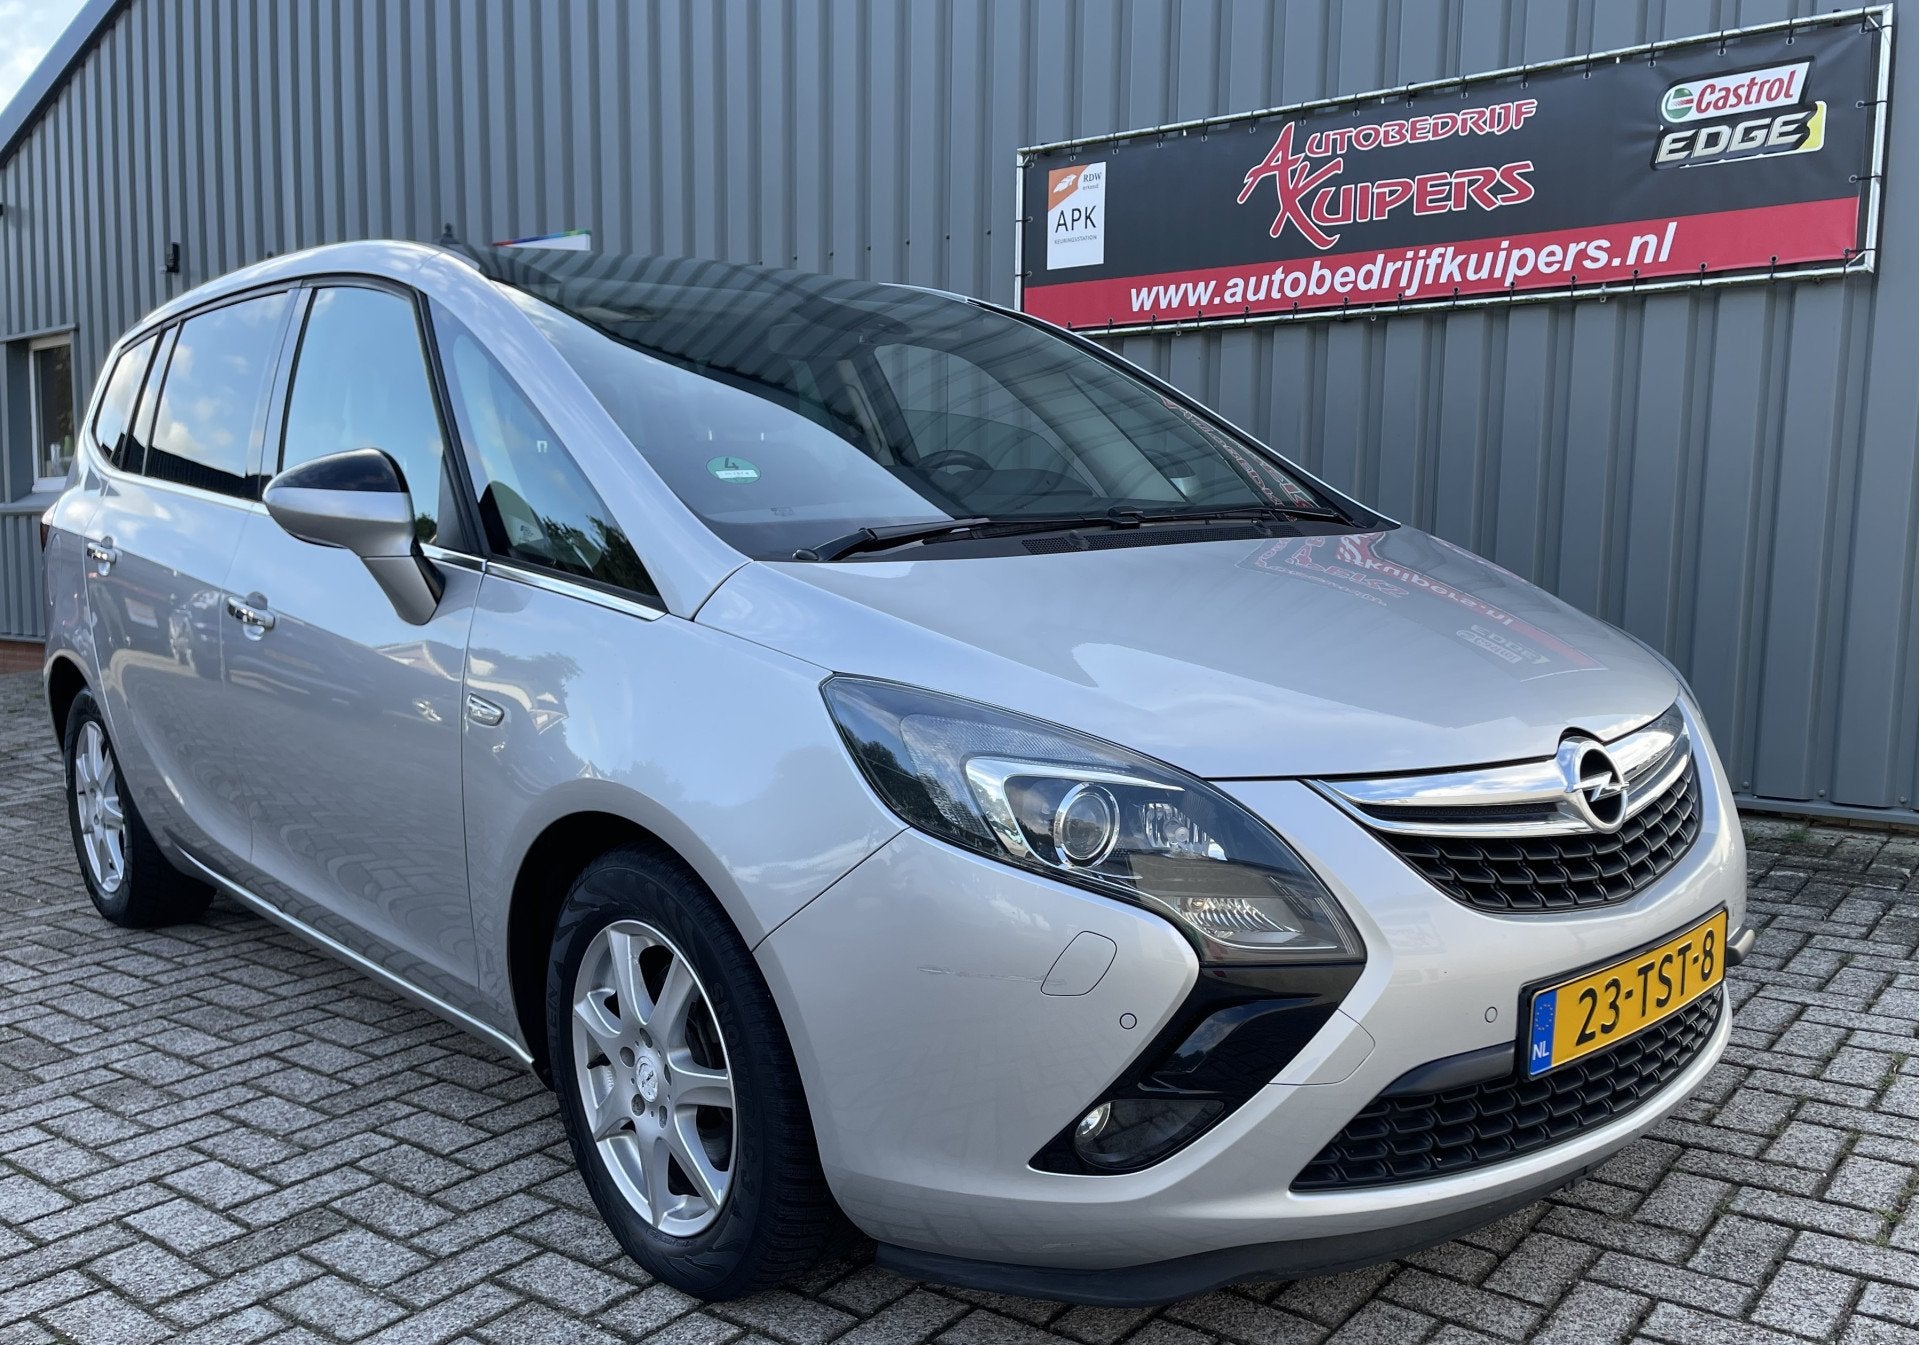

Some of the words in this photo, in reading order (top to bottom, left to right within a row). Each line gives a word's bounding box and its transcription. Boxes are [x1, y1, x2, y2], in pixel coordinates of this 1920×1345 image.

[1695, 69, 1797, 114] Castrol
[1236, 98, 1538, 204] AUTOBEDRIJF
[1655, 110, 1811, 164] EDGE
[1083, 172, 1101, 182] RDW
[1055, 205, 1097, 233] APK
[1269, 157, 1535, 250] KUIPERS
[1129, 221, 1678, 313] www.autobedrijfkuipers.nl
[724, 457, 739, 470] 4
[1575, 927, 1715, 1047] 23-TST-8
[1532, 1040, 1550, 1061] NL
